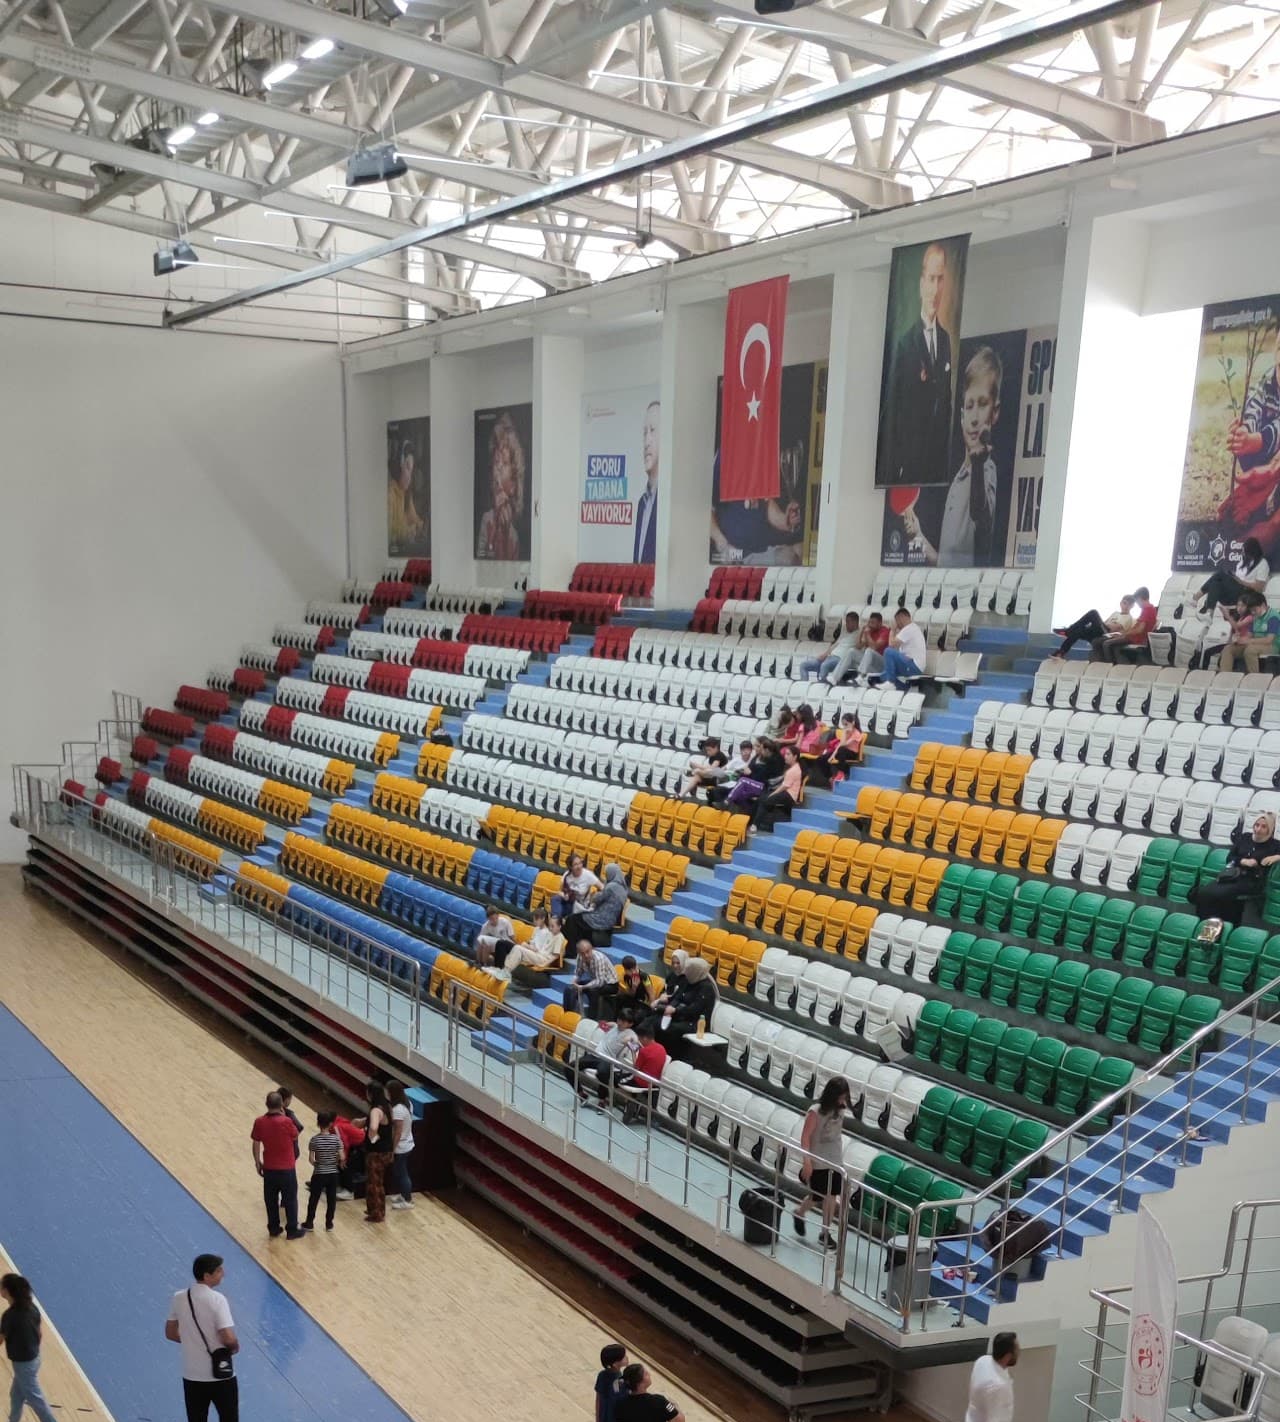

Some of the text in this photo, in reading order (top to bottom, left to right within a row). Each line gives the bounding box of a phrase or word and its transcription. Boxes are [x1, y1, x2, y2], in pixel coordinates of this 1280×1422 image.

[590, 457, 621, 477] SPORU
[587, 481, 624, 500] TABANA
[582, 503, 632, 522] YAYIYORUZ
